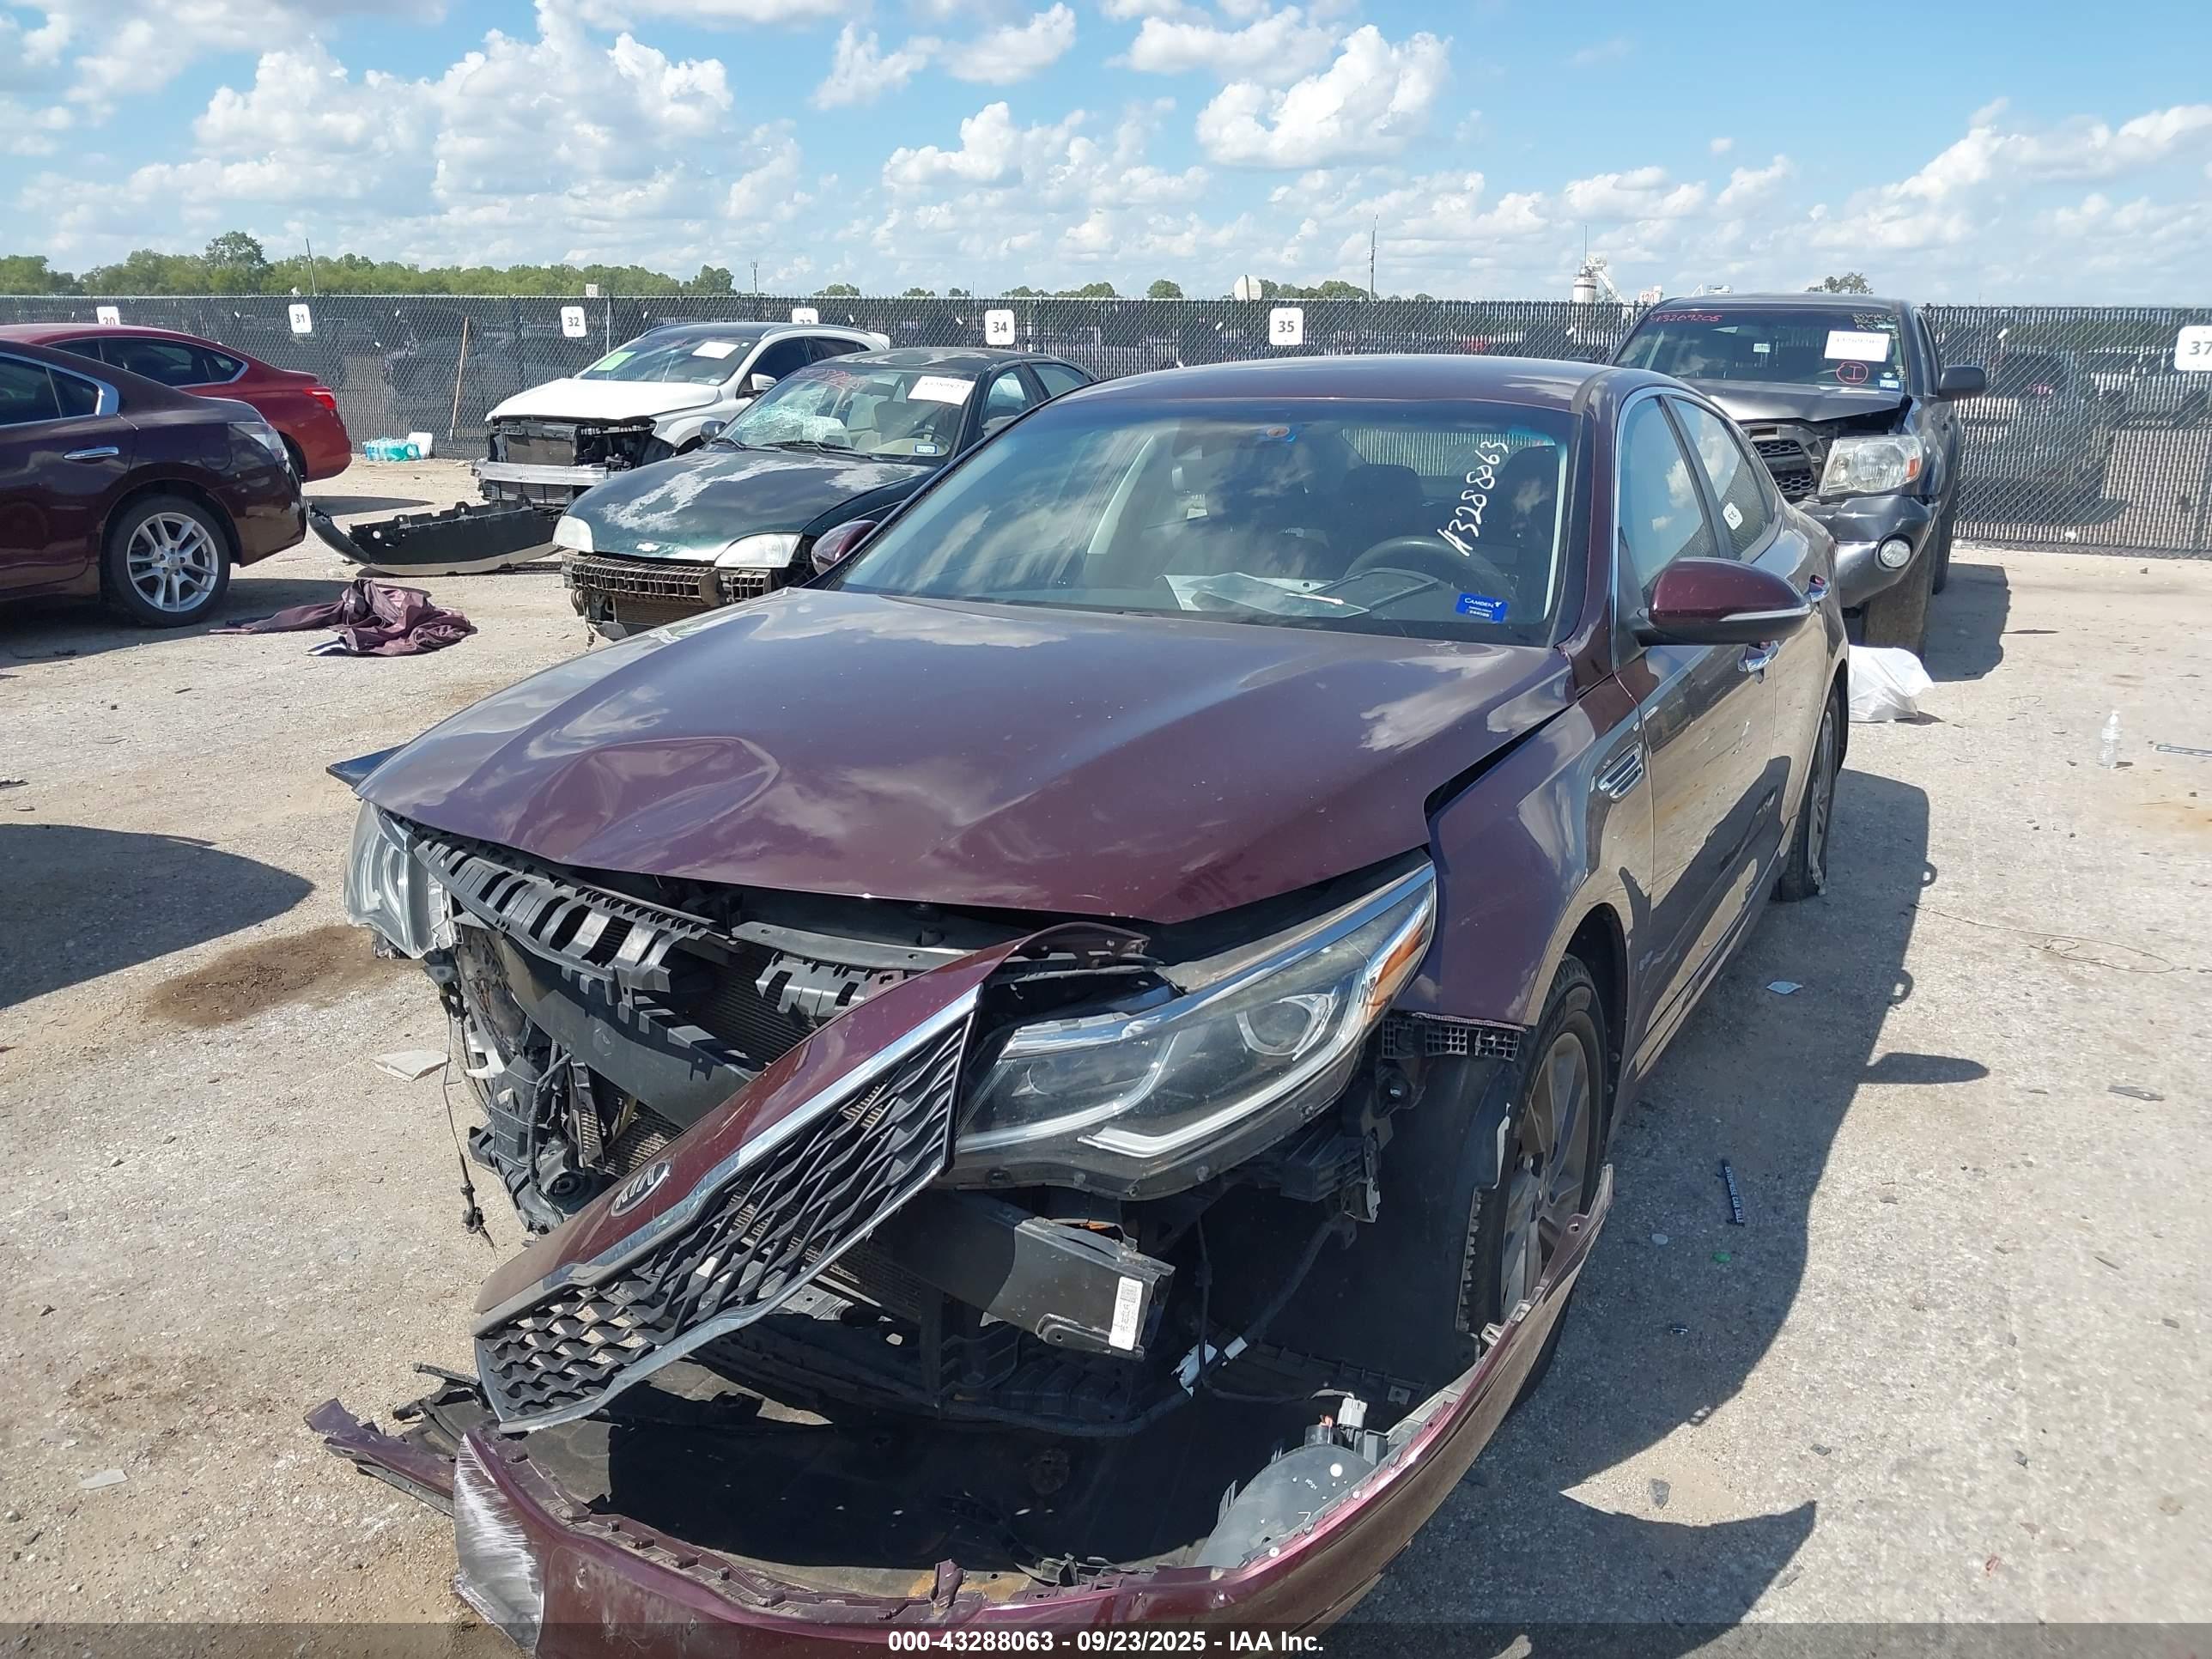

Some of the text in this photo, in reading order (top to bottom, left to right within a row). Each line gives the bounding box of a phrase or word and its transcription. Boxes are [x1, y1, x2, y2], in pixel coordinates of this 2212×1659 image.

[295, 313, 306, 324] 31
[568, 317, 580, 327] 32
[992, 321, 1007, 333] 34
[1278, 320, 1295, 333] 35
[2189, 341, 2212, 356] 37
[1464, 598, 1495, 609] CAMDEN
[615, 1165, 657, 1210] KIA
